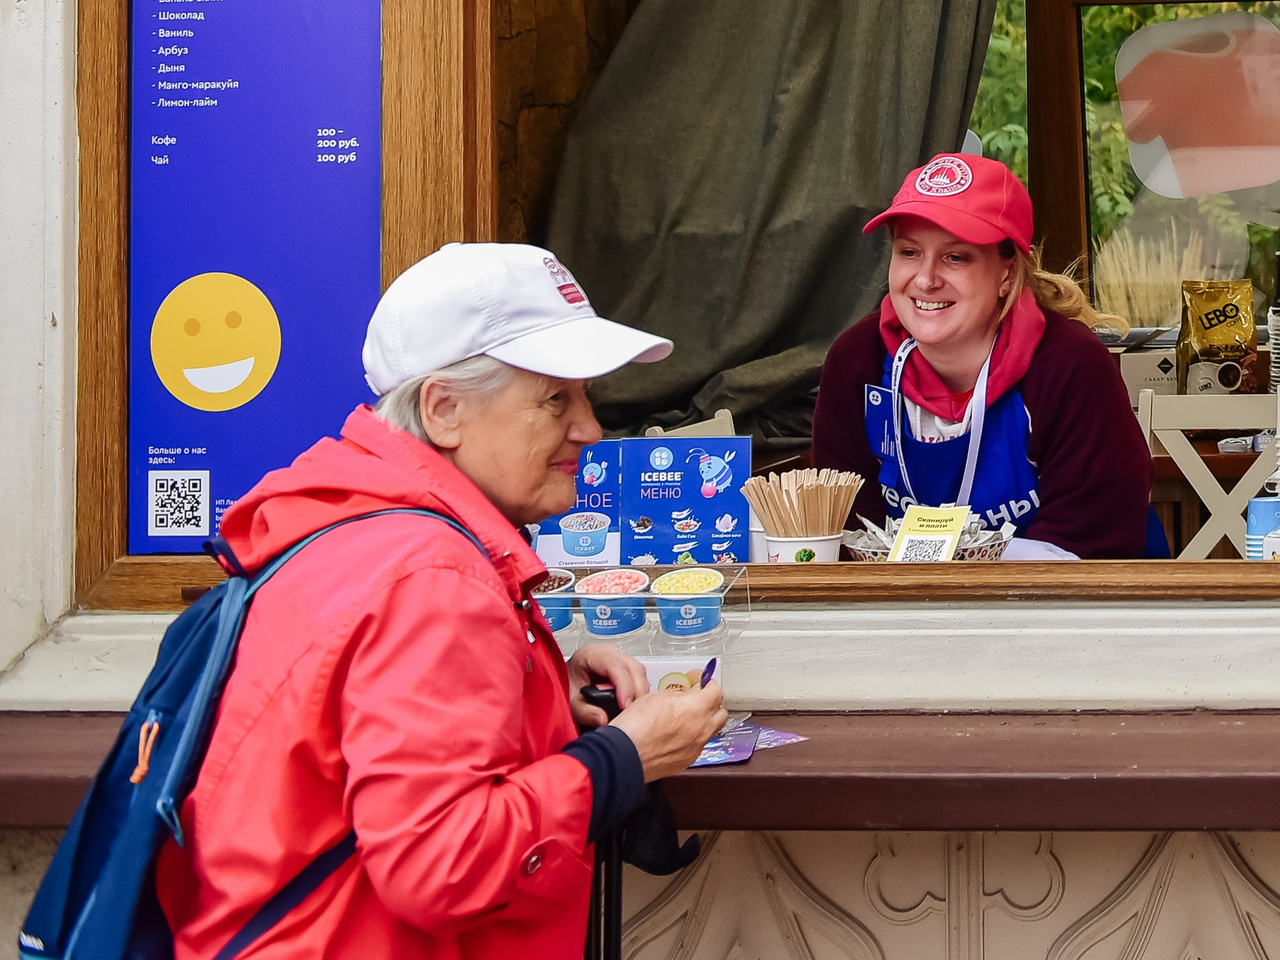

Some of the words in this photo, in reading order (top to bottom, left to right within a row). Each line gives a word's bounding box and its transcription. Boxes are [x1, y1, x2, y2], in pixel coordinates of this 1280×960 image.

[158, 11, 205, 21] Шоколад
[158, 29, 194, 38] Ваниль
[158, 46, 188, 57] Арбуз
[158, 63, 185, 74] Дыня
[158, 79, 239, 91] Манго-маракуйя
[157, 97, 218, 107] Лимон-лайм
[317, 128, 336, 137] 100
[151, 135, 177, 146] Кофе
[317, 139, 337, 148] 200
[338, 139, 360, 150] руб.
[151, 155, 169, 165] Чай
[317, 153, 336, 162] 100
[338, 153, 357, 164] руб
[1199, 303, 1240, 331] LEBO
[148, 446, 182, 454] Больше
[640, 472, 681, 482] ICEBEE
[640, 487, 682, 499] МЕНЮ
[570, 493, 612, 508] НОЕ
